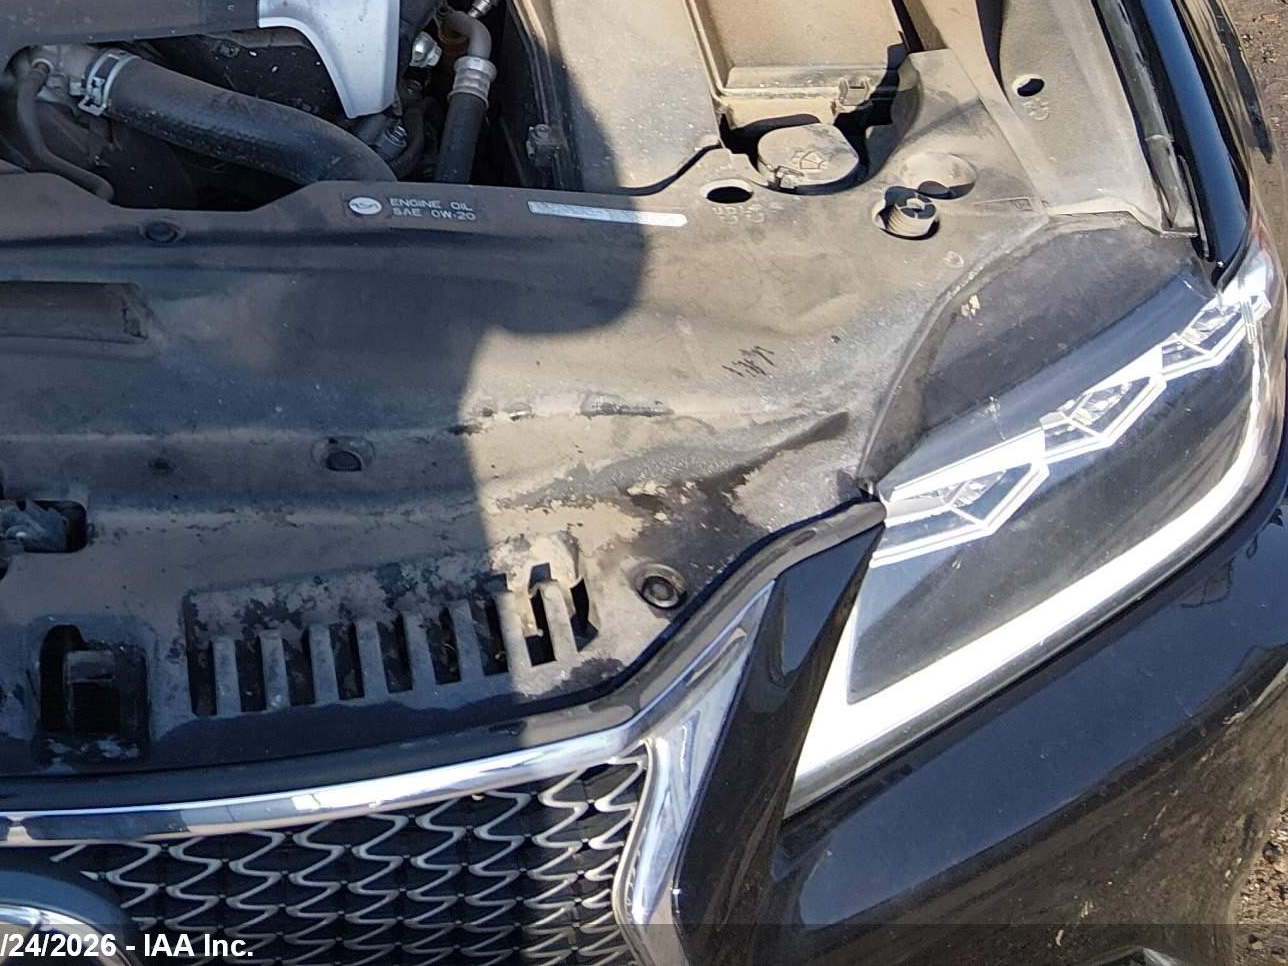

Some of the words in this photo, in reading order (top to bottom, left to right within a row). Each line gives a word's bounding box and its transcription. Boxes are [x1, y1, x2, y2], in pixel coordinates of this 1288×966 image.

[389, 197, 441, 209] ENGINE
[450, 201, 473, 212] OIL
[392, 207, 423, 218] SAE
